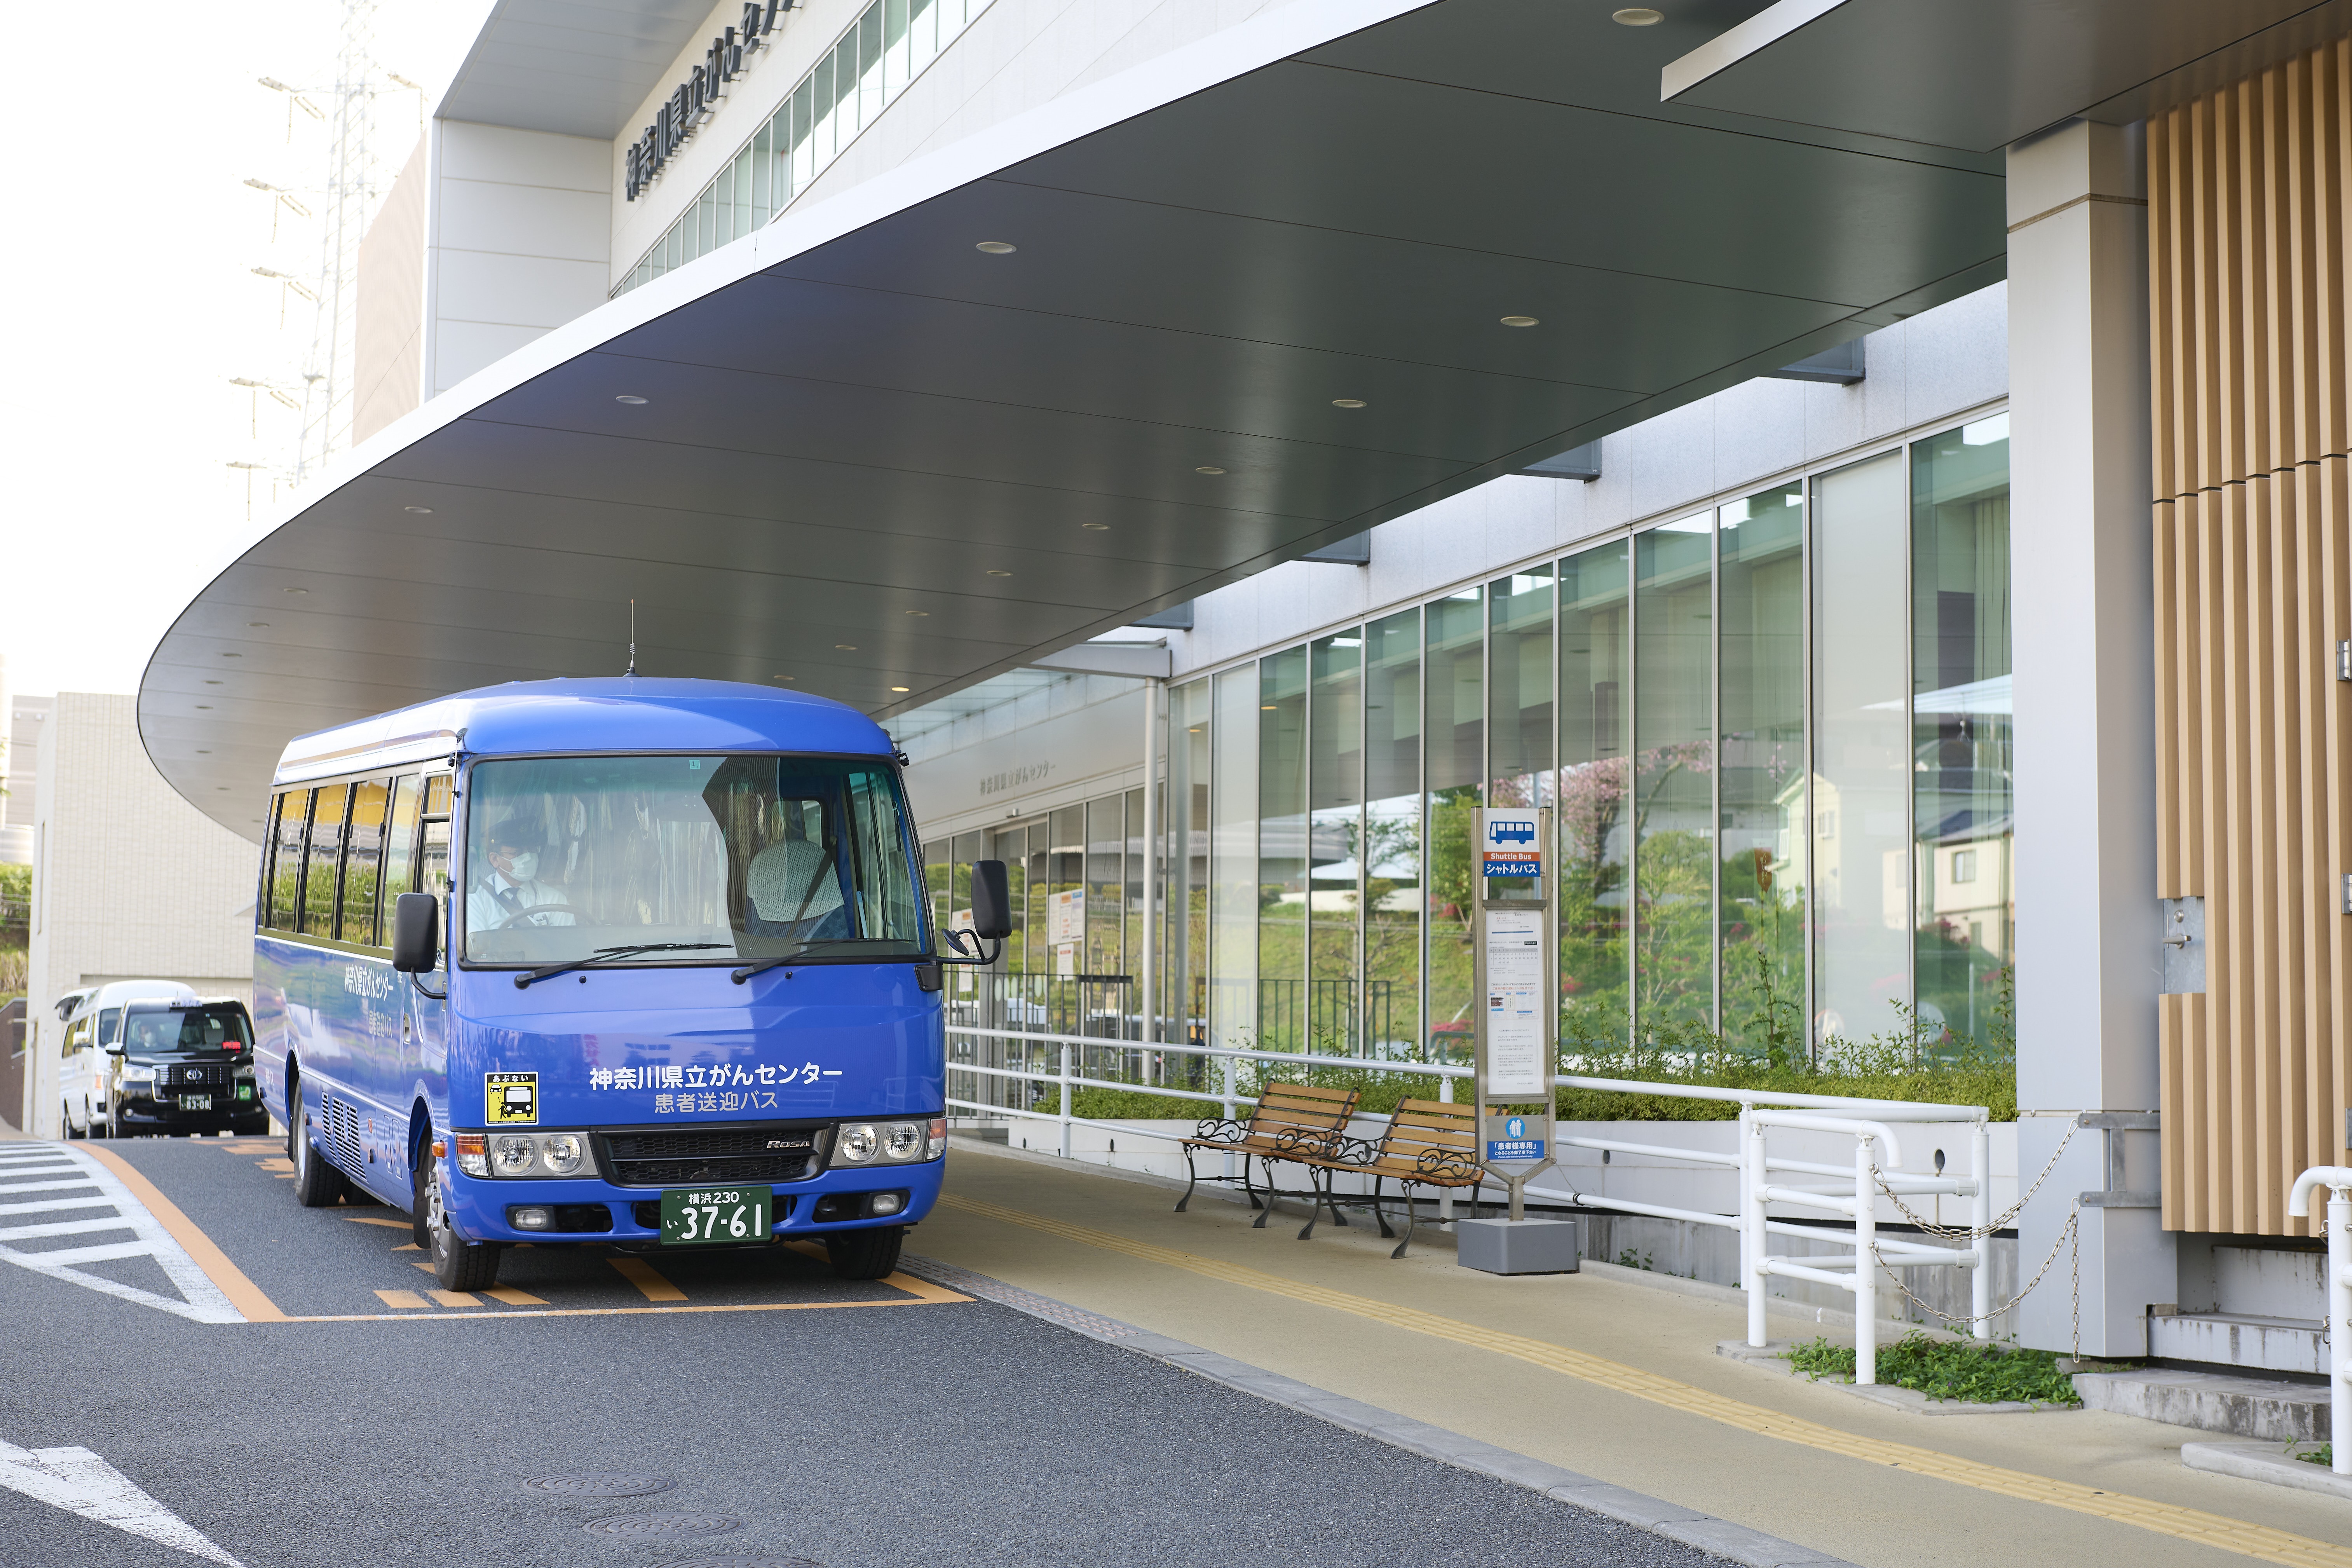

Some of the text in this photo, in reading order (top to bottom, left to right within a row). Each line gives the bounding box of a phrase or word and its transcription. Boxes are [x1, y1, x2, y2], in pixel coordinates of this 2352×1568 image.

[980, 760, 1056, 796] 神奈川県立がんセンター
[1486, 864, 1537, 874] シャトルバス
[344, 963, 393, 1001] 神奈川県立がんセンター
[370, 1009, 392, 1038] 患者送迎バス
[589, 1062, 842, 1090] 神奈川県立がんセンター
[186, 1100, 209, 1110] 83-08
[655, 1090, 778, 1113] 患者送迎バス
[767, 1140, 810, 1148] ROSA
[1494, 1142, 1536, 1150] 「患者様専用」
[689, 1191, 739, 1204] 横浜230
[667, 1204, 761, 1240] い 37-61
